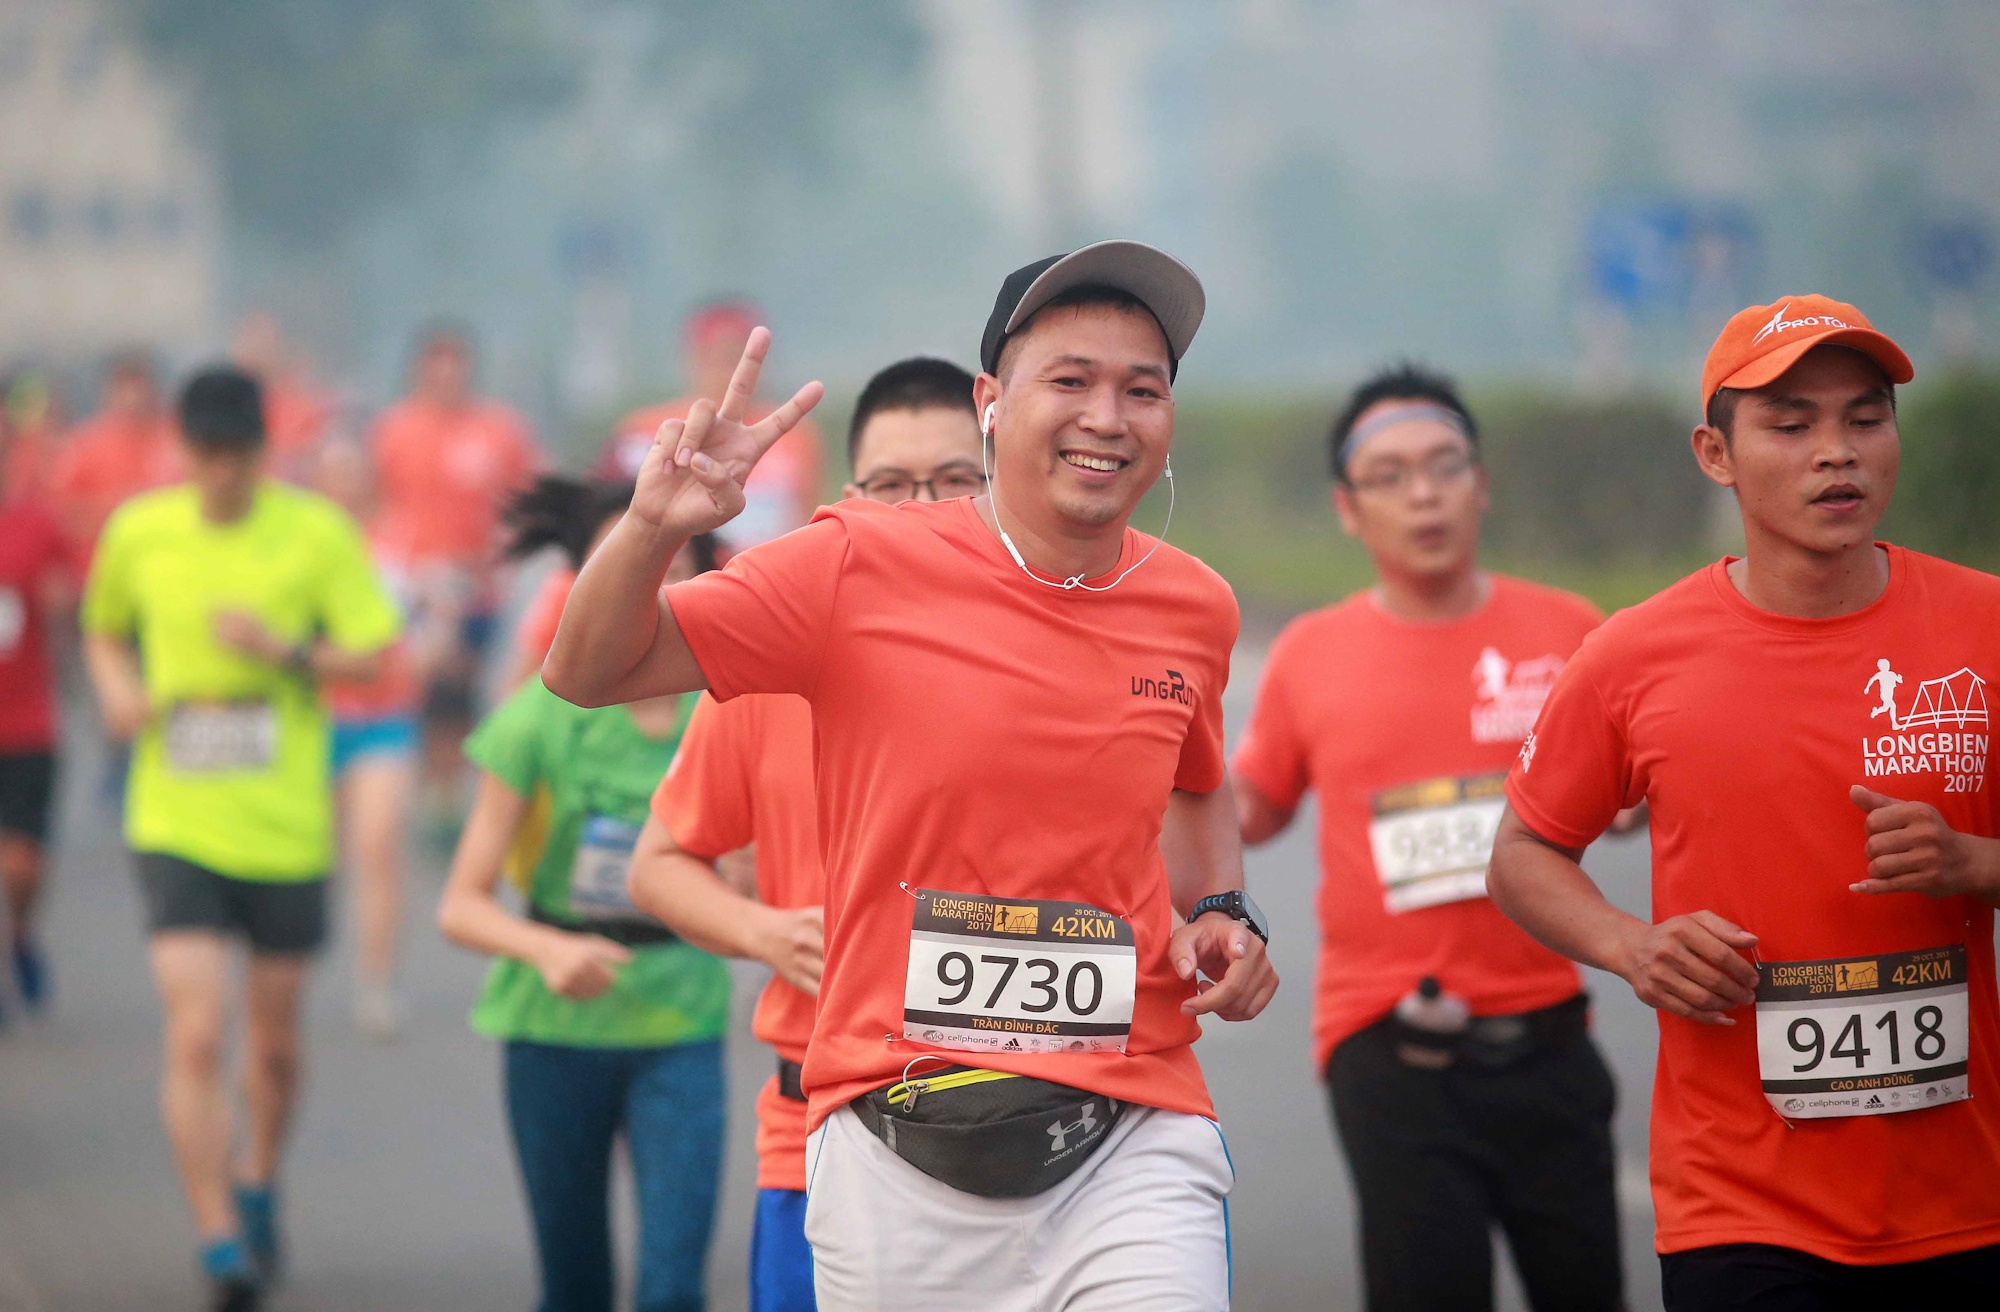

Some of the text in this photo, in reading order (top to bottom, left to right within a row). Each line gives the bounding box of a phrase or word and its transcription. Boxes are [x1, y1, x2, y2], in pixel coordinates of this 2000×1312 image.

[1776, 315, 1857, 333] PRO TOU
[1862, 733, 1989, 758] LONGBIEN
[1864, 754, 1987, 777] MARATHON
[1943, 774, 1984, 793] 2017
[932, 897, 994, 913] LONGBIEN
[1074, 908, 1083, 916] 29
[931, 908, 993, 922] MARATHON
[966, 921, 992, 931] 2017
[1051, 916, 1116, 939] 42KM
[1772, 964, 1833, 978] LONGBIEN
[1891, 960, 1952, 985] 42KM
[936, 951, 1103, 1016] 9730
[1772, 975, 1834, 986] MARATHON
[1809, 984, 1834, 994] 2017
[972, 1016, 1002, 1029] TRẦN
[1004, 1019, 1033, 1032] ĐÌNH
[1786, 1005, 1946, 1073] 9418
[1830, 1073, 1915, 1091] CAO ANH DŨNG
[1864, 1102, 1885, 1110] adidas
[1044, 1147, 1073, 1167] UNDER
